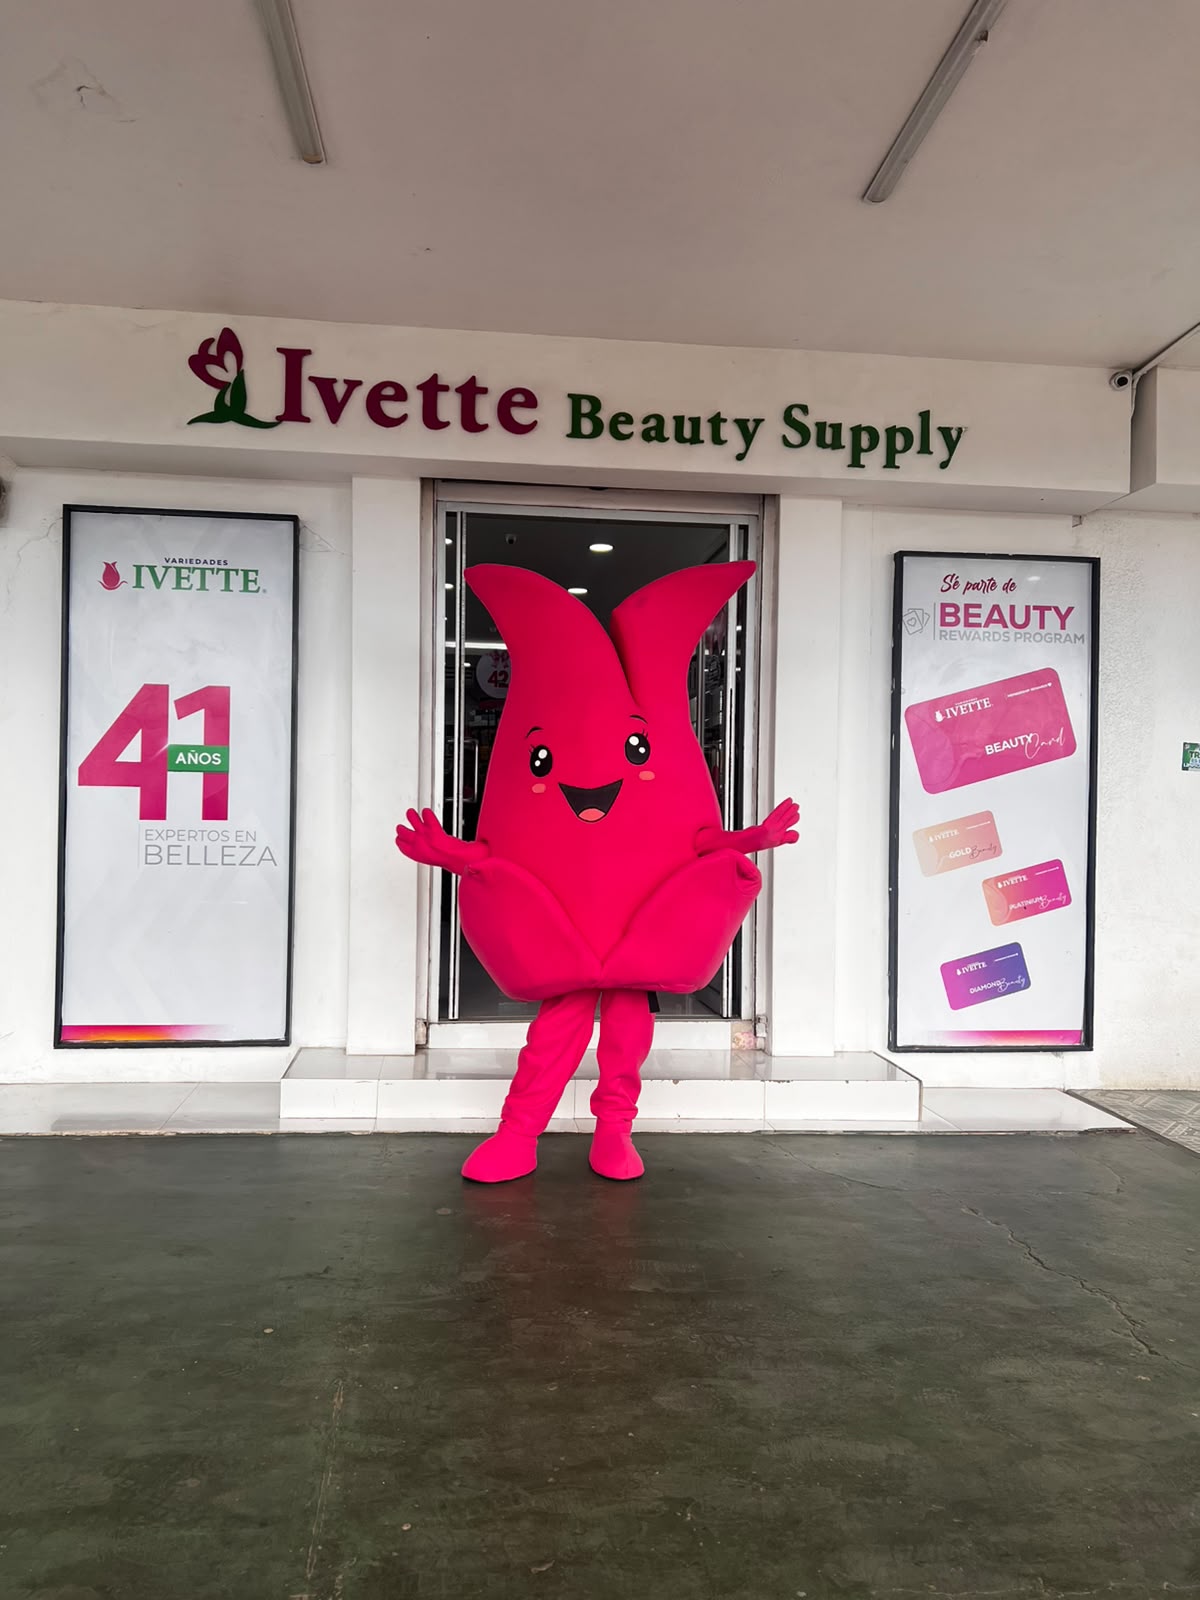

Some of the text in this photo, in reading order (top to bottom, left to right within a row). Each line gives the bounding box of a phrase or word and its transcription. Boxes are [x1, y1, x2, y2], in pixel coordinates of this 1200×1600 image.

[275, 347, 967, 469] Ivette Beauty Supply
[164, 557, 229, 566] VARIEDADES
[132, 564, 261, 594] IVETTE
[940, 574, 1017, 595] Sé parte de
[939, 602, 1075, 631] BEAUTY
[939, 630, 1085, 645] REWARDS PROGRAM
[945, 697, 992, 719] IVETTE
[78, 683, 231, 821] 41
[984, 733, 1034, 756] BEAUTY
[175, 750, 222, 765] AÑOS
[144, 828, 257, 842] EXPERTOS EN
[144, 844, 278, 867] BELLEZA
[949, 847, 972, 859] GOLD
[969, 979, 1002, 994] DIAMOND
